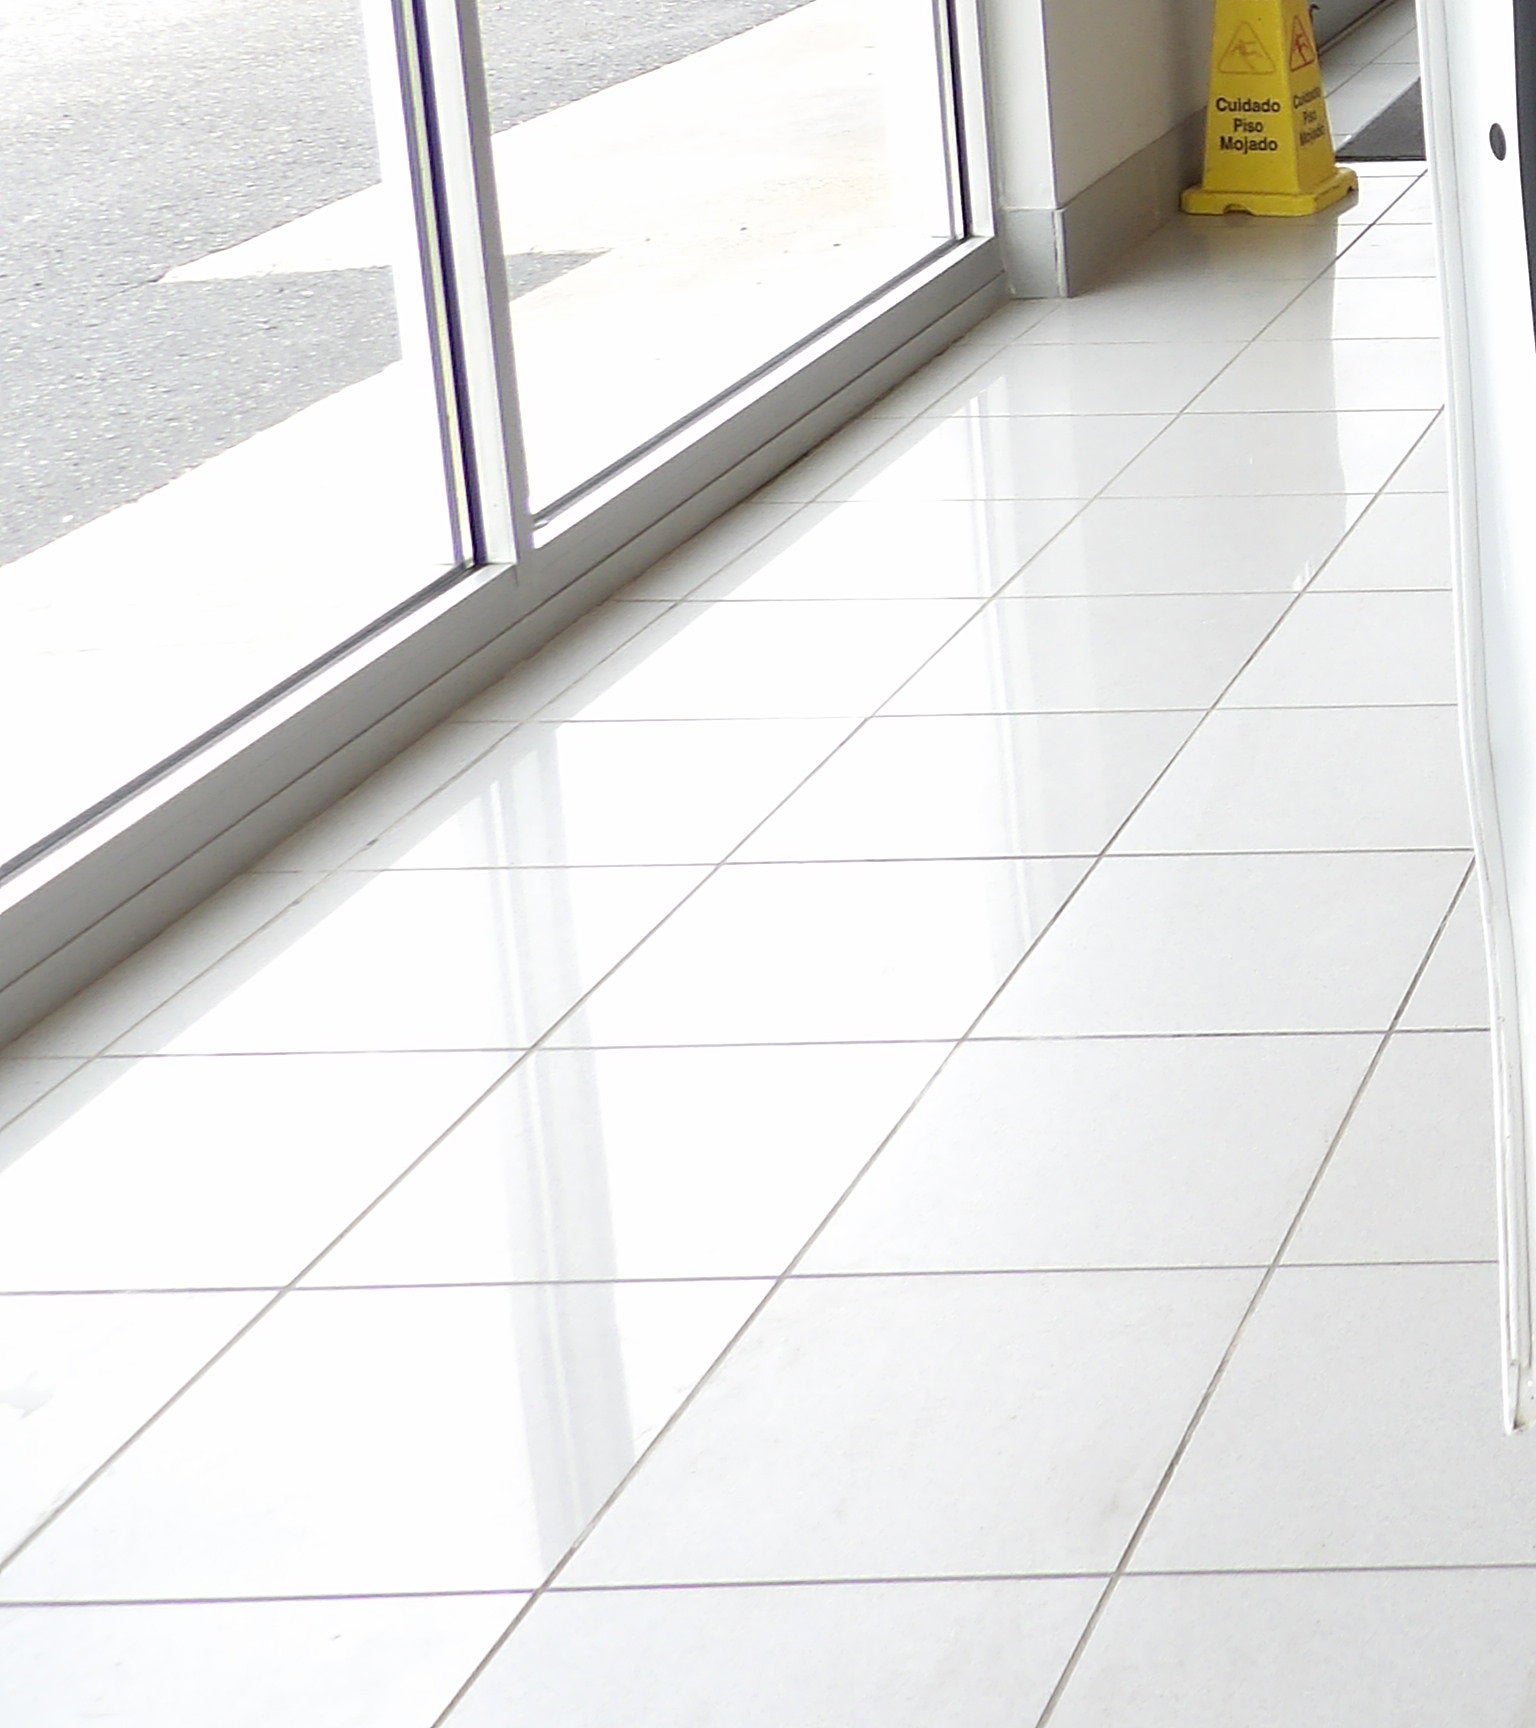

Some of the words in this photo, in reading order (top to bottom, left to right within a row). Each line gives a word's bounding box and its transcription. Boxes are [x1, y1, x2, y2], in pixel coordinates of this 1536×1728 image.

[1216, 97, 1281, 112] Cuidado
[1233, 117, 1263, 133] Piso
[1219, 136, 1278, 155] Mojado
